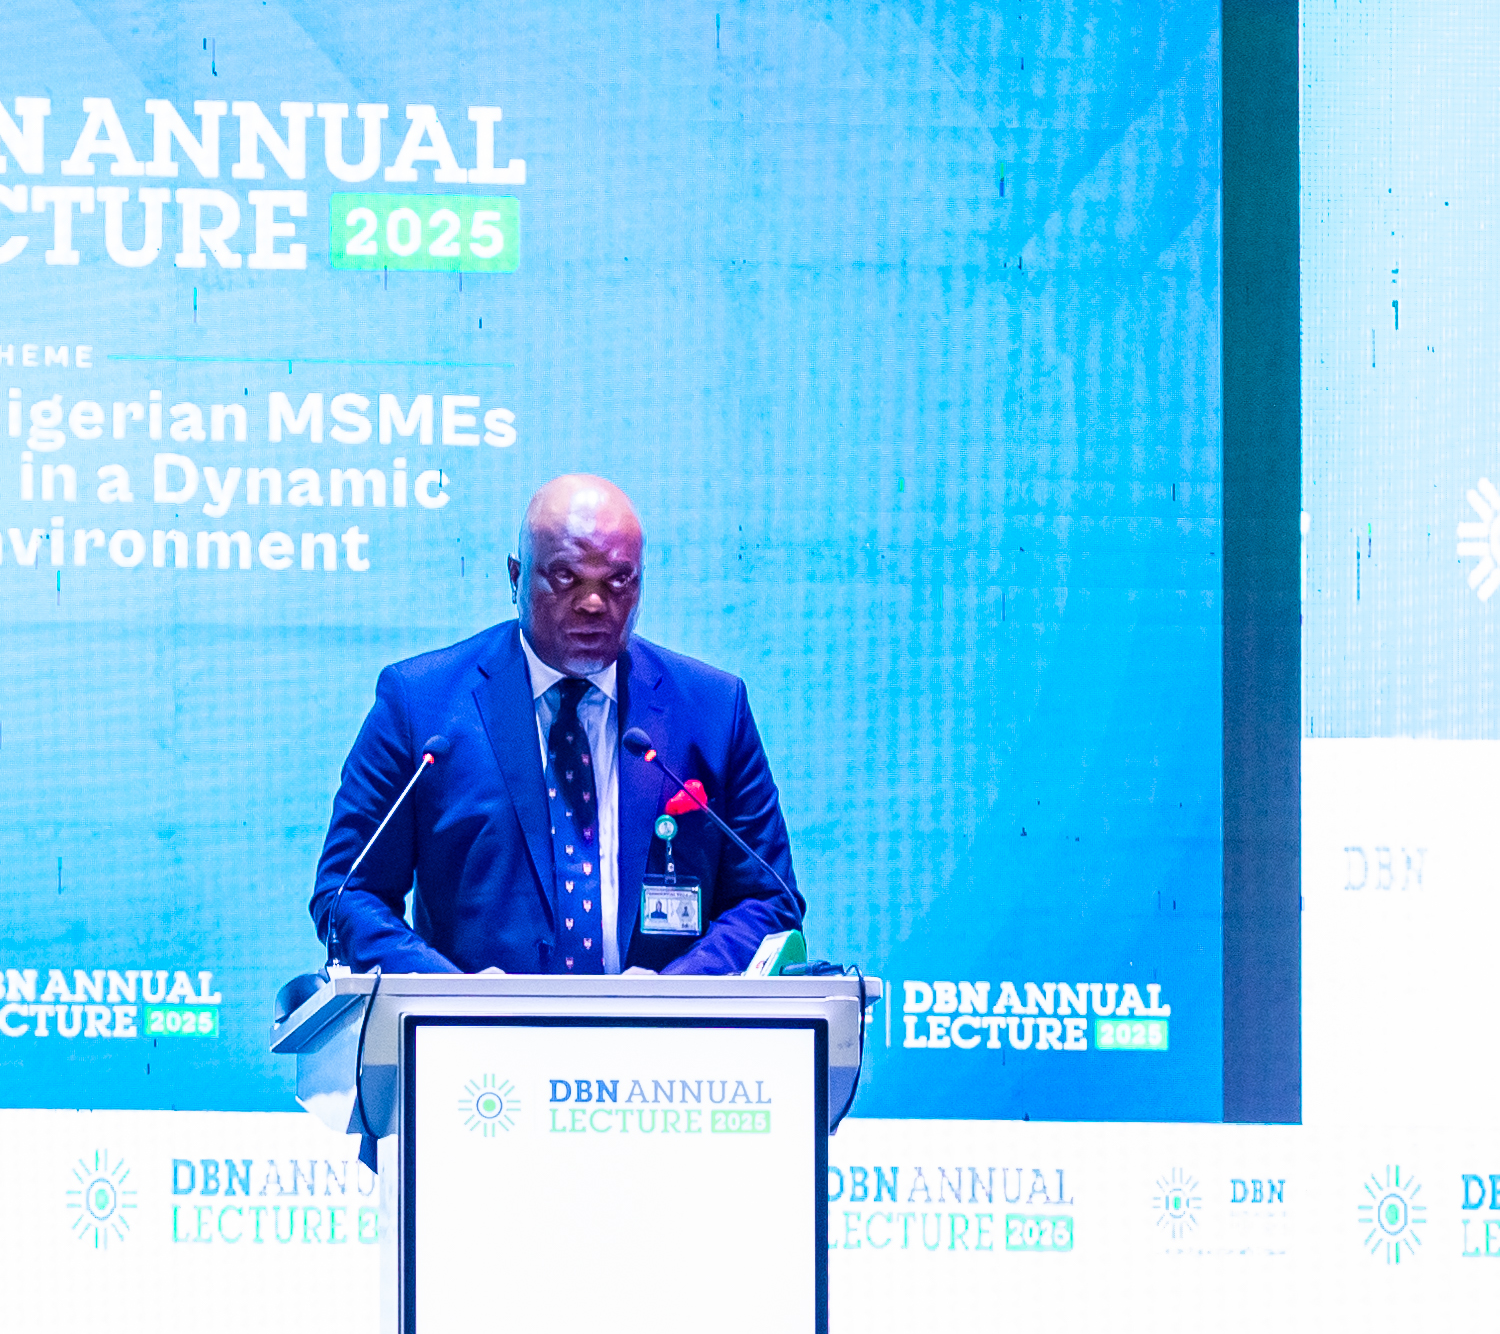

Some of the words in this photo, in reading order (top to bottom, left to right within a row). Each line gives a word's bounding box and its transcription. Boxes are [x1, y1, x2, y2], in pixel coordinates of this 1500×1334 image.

[62, 99, 525, 186] ANNUAL
[344, 206, 506, 257] 2025
[268, 393, 517, 449] MSMEs
[20, 452, 75, 503] in
[95, 464, 131, 504] a
[153, 458, 450, 519] Dynamic
[42, 968, 221, 1003] ANNUAL
[904, 981, 991, 1013] DBN
[994, 982, 1170, 1016] ANNUAL
[151, 1012, 213, 1034] 2025
[904, 1016, 1088, 1051] LECTURE
[1101, 1024, 1162, 1046] 2025
[550, 1080, 619, 1102] DBN
[625, 1080, 771, 1104] ANNUAL
[550, 1109, 702, 1133] LECTURE
[172, 1158, 253, 1196] DBN
[259, 1158, 377, 1196] ANNU
[908, 1167, 1073, 1204] ANNUAL
[1230, 1179, 1286, 1204] DBN
[172, 1204, 347, 1244] LECTURE
